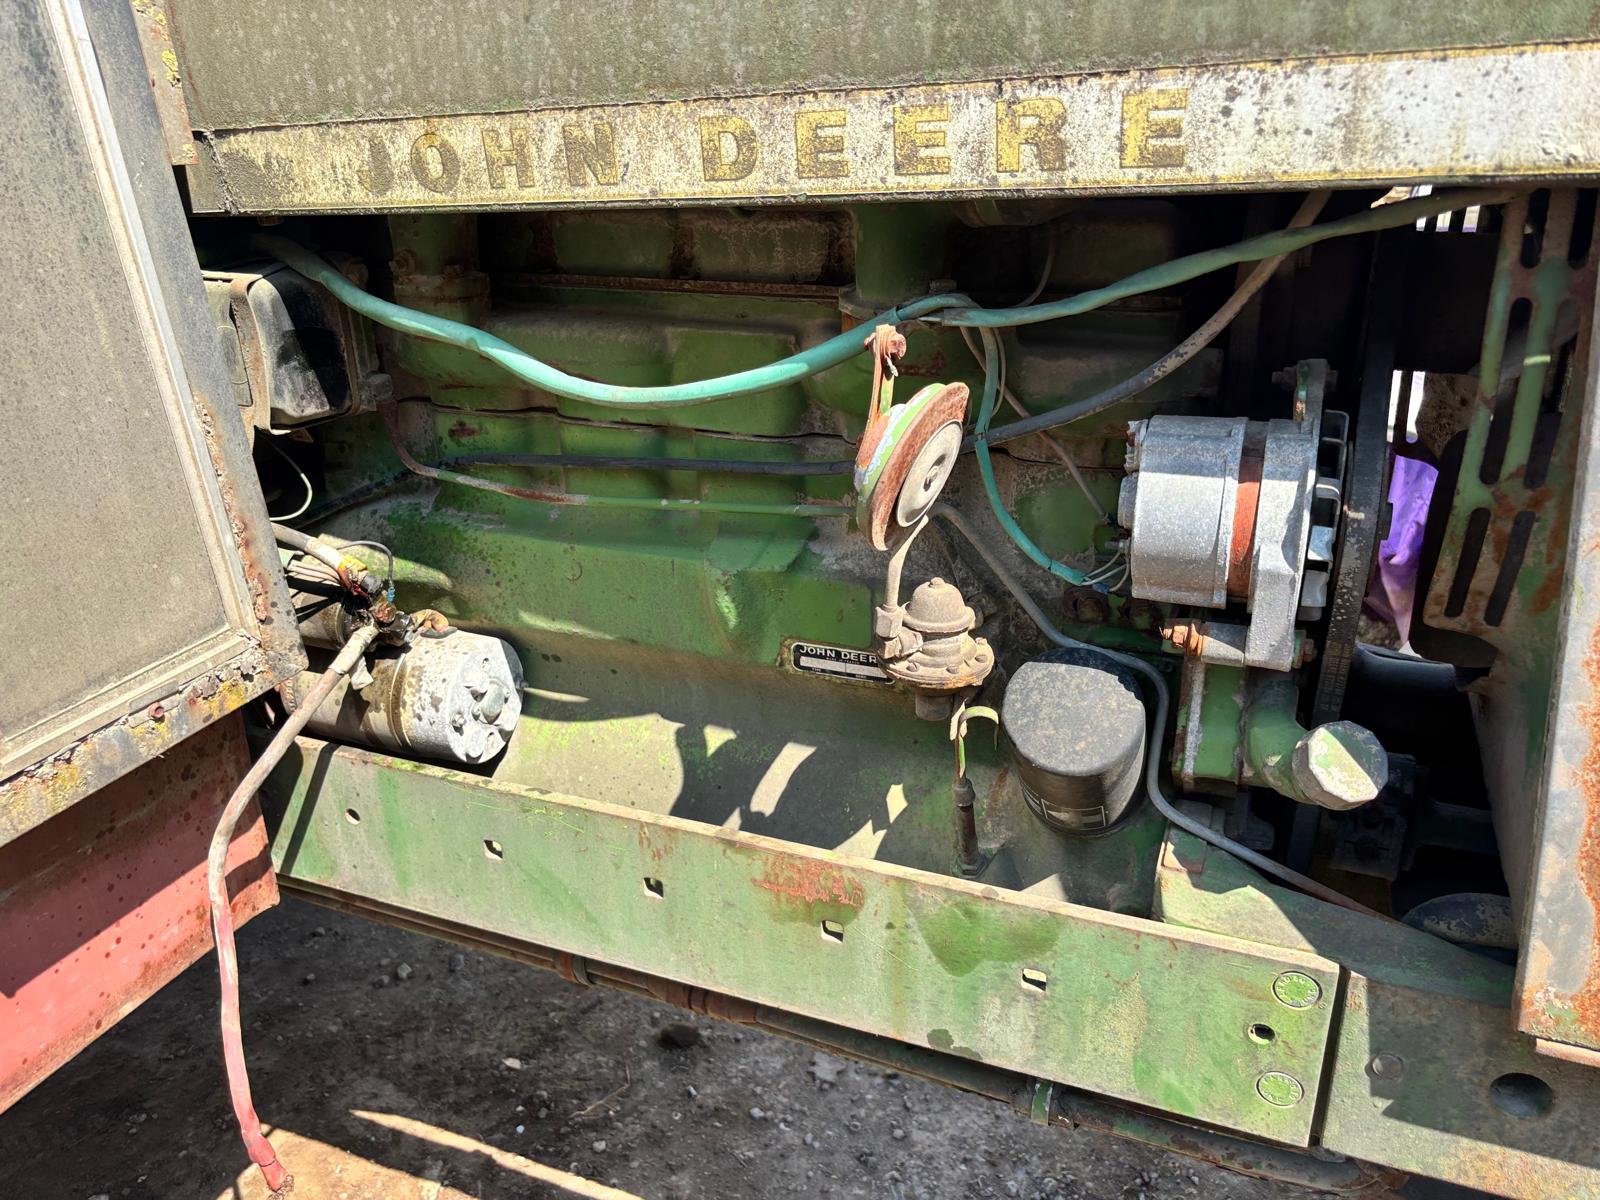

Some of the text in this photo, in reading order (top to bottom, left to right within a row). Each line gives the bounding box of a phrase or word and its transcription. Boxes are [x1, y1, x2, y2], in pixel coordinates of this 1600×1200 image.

[356, 87, 1191, 194] JOHN DEERE
[799, 645, 879, 664] JOHN DEER
